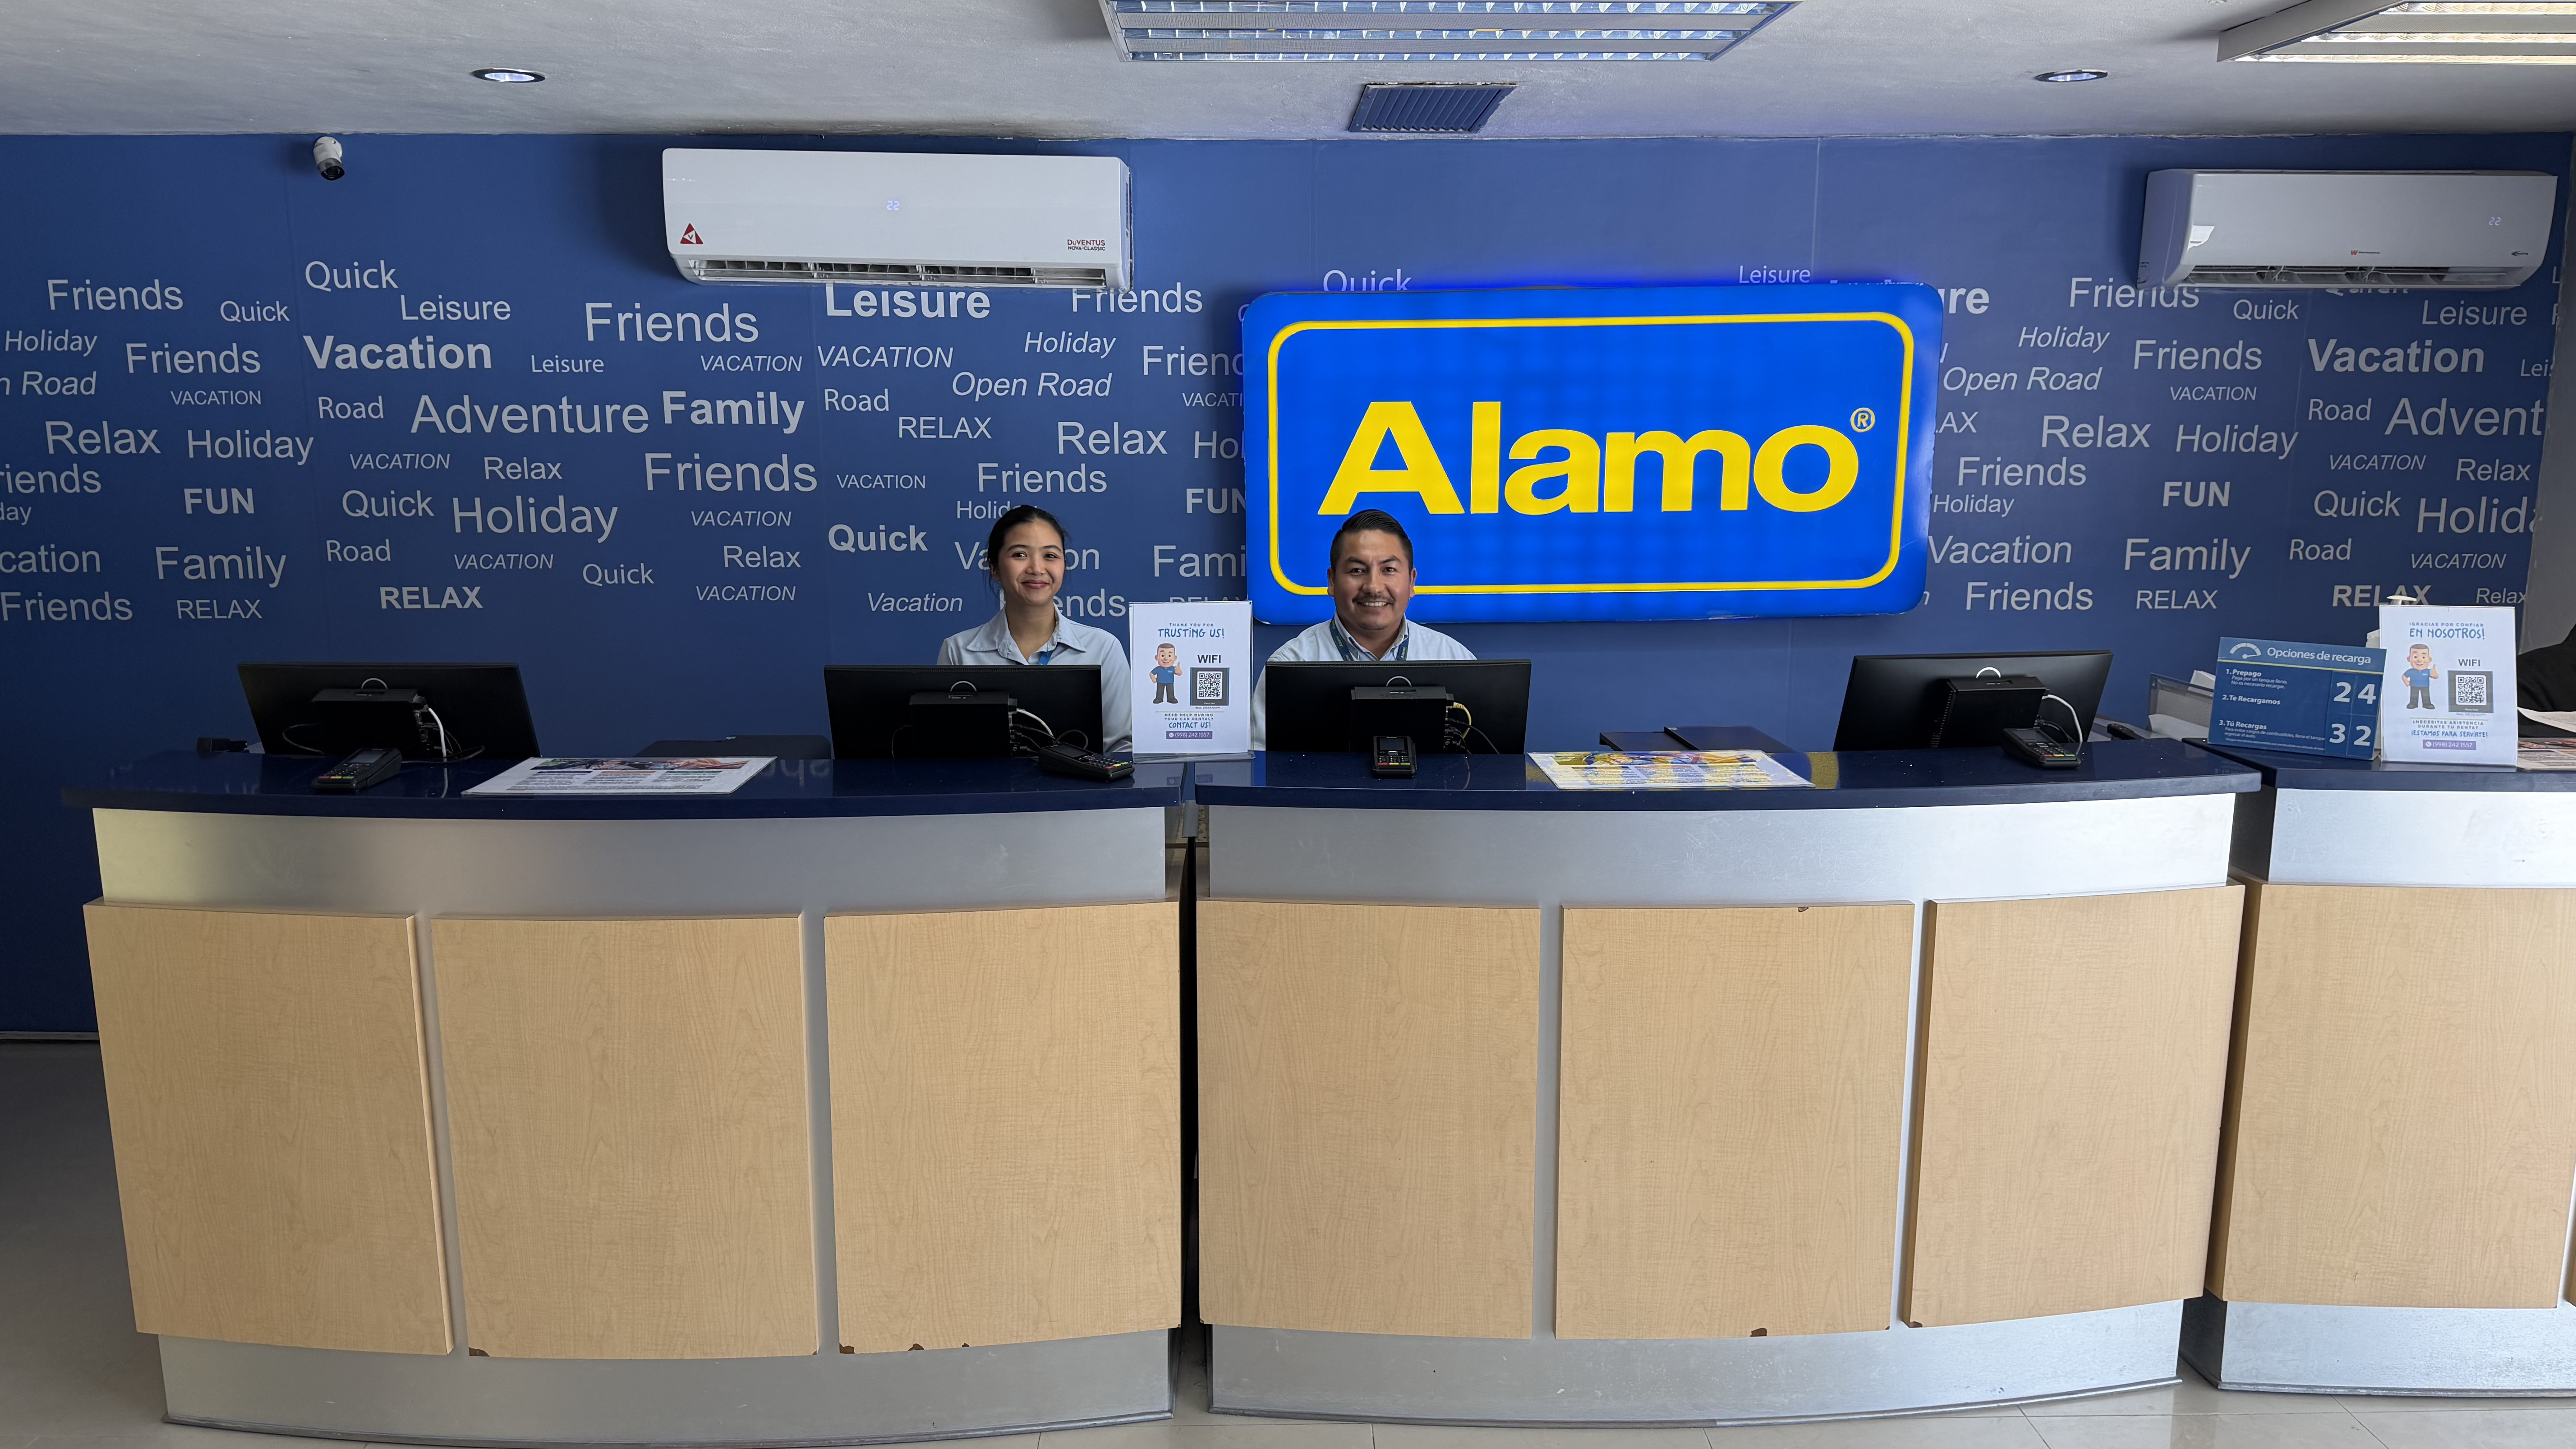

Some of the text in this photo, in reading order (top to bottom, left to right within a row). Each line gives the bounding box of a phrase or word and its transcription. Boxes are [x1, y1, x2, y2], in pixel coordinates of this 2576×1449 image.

[887, 200, 900, 210] 22
[305, 260, 399, 292] Quick
[1739, 265, 1811, 284] Leisure
[47, 279, 183, 310] Friends
[825, 282, 991, 318] Leisure
[220, 300, 290, 322] Quick
[400, 294, 511, 320] Leisure
[2233, 299, 2299, 321] Quick
[2422, 300, 2527, 325] Leisure
[585, 303, 759, 342] Friends
[5, 329, 98, 357] Holiday
[1025, 331, 1116, 359] Holiday
[2018, 326, 2110, 353] Holiday
[126, 343, 261, 373] Friends
[303, 335, 492, 369] Vacation
[531, 355, 604, 373] Leisure
[700, 355, 802, 372] VACATION
[817, 345, 953, 368] VACATION
[2134, 340, 2262, 370] Friends
[2308, 338, 2484, 373] Vacation
[22, 371, 97, 395] Road
[952, 372, 1113, 402] Open Road
[1943, 367, 2103, 396] Open Road
[2170, 386, 2257, 401] VACATION
[170, 390, 261, 405] VACATION
[318, 395, 384, 419] Road
[824, 388, 889, 412] Road
[2308, 398, 2372, 421] Road
[410, 395, 649, 433] Adventure
[662, 391, 805, 434] Family
[45, 421, 161, 455] Relax
[899, 416, 992, 439] RELAX
[1058, 422, 1168, 455] Relax
[2042, 415, 2151, 448] Relax
[188, 429, 314, 465] Holiday
[2176, 424, 2299, 460] Holiday
[350, 453, 450, 469] VACATION
[484, 457, 563, 480] Relax
[1317, 400, 1859, 515] Alamo
[2330, 455, 2426, 470] VACATION
[2456, 458, 2531, 481] Relax
[645, 453, 817, 492] Friends
[836, 474, 925, 489] VACATION
[978, 463, 1107, 493] Friends
[1958, 456, 2086, 486] Friends
[184, 488, 254, 515] FUN
[342, 490, 435, 518] Quick
[1933, 494, 2015, 517] Holiday
[2162, 481, 2230, 507] FUN
[2314, 490, 2401, 518] Quick
[453, 495, 618, 543] Holiday
[691, 511, 791, 526] VACATION
[326, 538, 391, 562] Road
[828, 524, 928, 553] Quick
[1928, 535, 2072, 564] Vacation
[2289, 538, 2352, 561] Road
[156, 546, 286, 588] Family
[454, 554, 554, 569] VACATION
[723, 545, 801, 568] Relax
[2125, 538, 2251, 579] Family
[2411, 553, 2507, 569] VACATION
[583, 562, 654, 587] Quick
[380, 586, 483, 609] RELAX
[696, 585, 796, 601] VACATION
[868, 593, 963, 612] Vacation
[1966, 581, 2093, 611] Friends
[2136, 590, 2217, 609] RELAX
[0, 591, 133, 621] Friends
[177, 599, 262, 619] RELAX
[1210, 628, 1224, 639] US!
[2410, 628, 2485, 640] EN NOSOTROS!
[1197, 655, 1222, 663] WIFI
[2267, 648, 2371, 666] Opciones de recarga
[2458, 659, 2480, 667] WIFI
[2232, 669, 2262, 677] Prepago
[2238, 696, 2281, 705] Recargamos
[2236, 722, 2267, 730] Recargas
